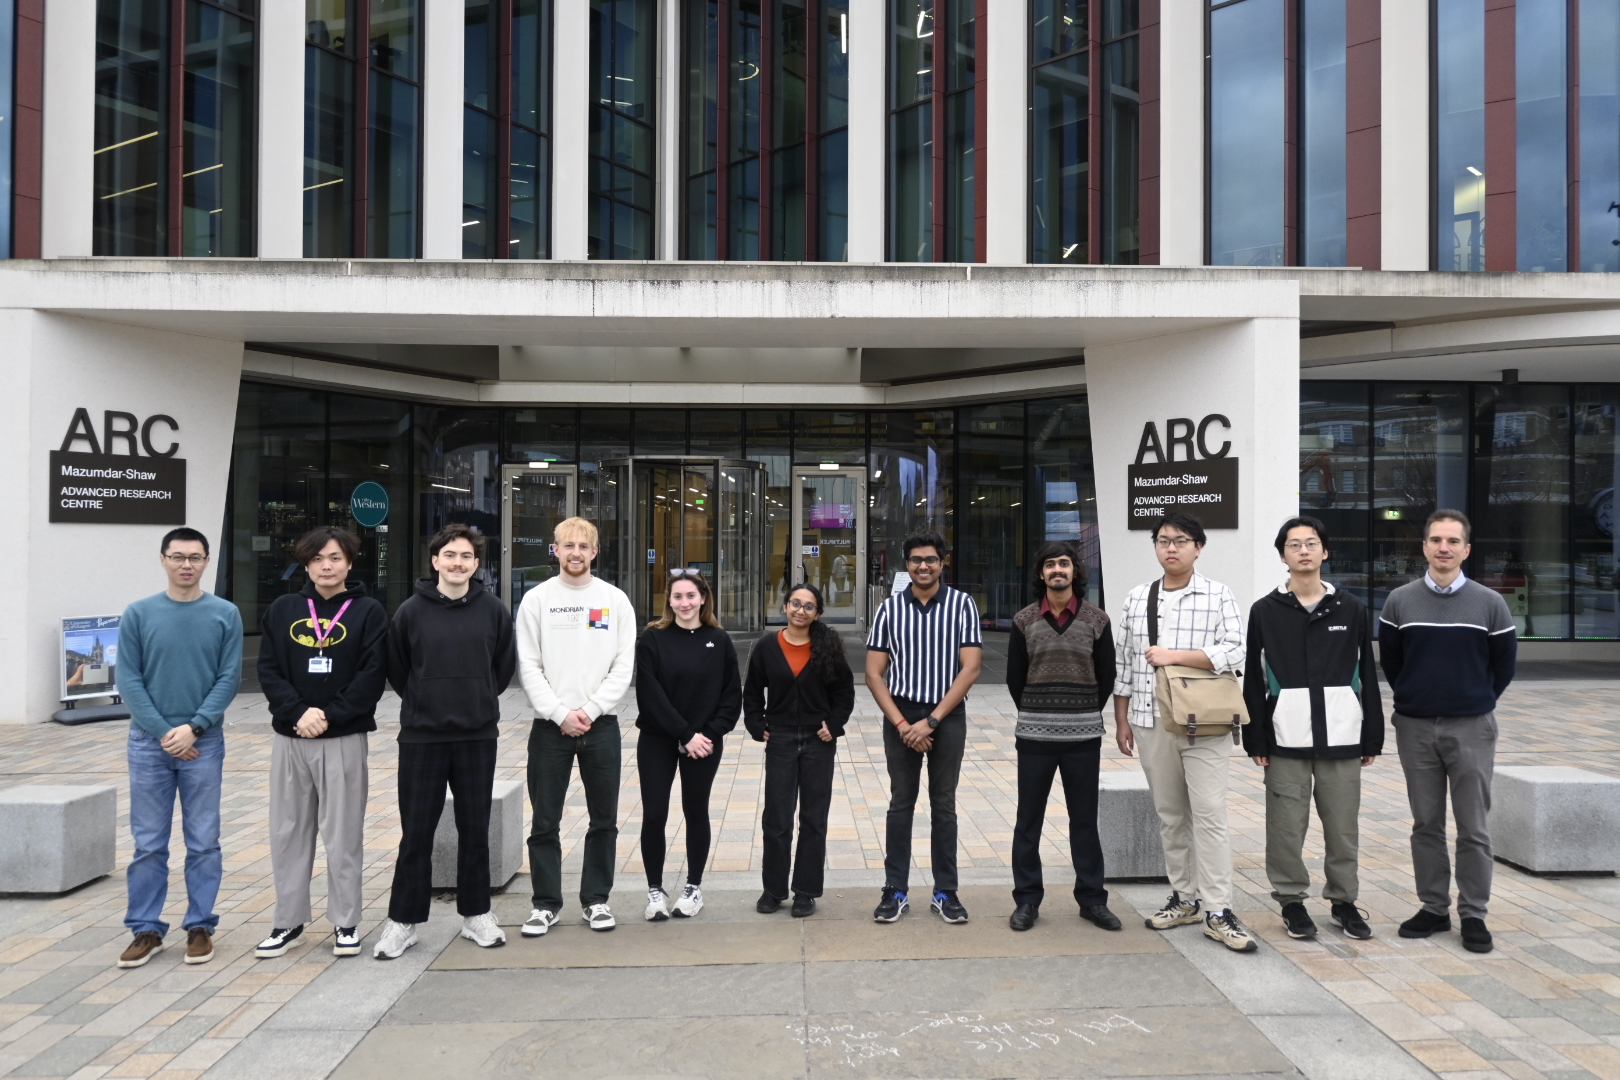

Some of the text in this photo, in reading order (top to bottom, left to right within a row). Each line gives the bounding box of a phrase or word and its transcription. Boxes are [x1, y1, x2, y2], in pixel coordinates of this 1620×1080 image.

[59, 407, 180, 459] ARC
[1134, 413, 1232, 465] ARC
[61, 465, 157, 481] Mazumdar-Shaw
[1134, 474, 1208, 487] Mazumdar-Shaw
[60, 486, 172, 500] ADVANCED RESEARCH
[1133, 493, 1222, 506] ADVANCED RESEARCH
[60, 498, 103, 509] CENTRE
[352, 498, 386, 509] Western
[1133, 507, 1165, 517] CENTRE
[549, 606, 585, 614] MONDRIAN
[566, 613, 584, 623] 1921
